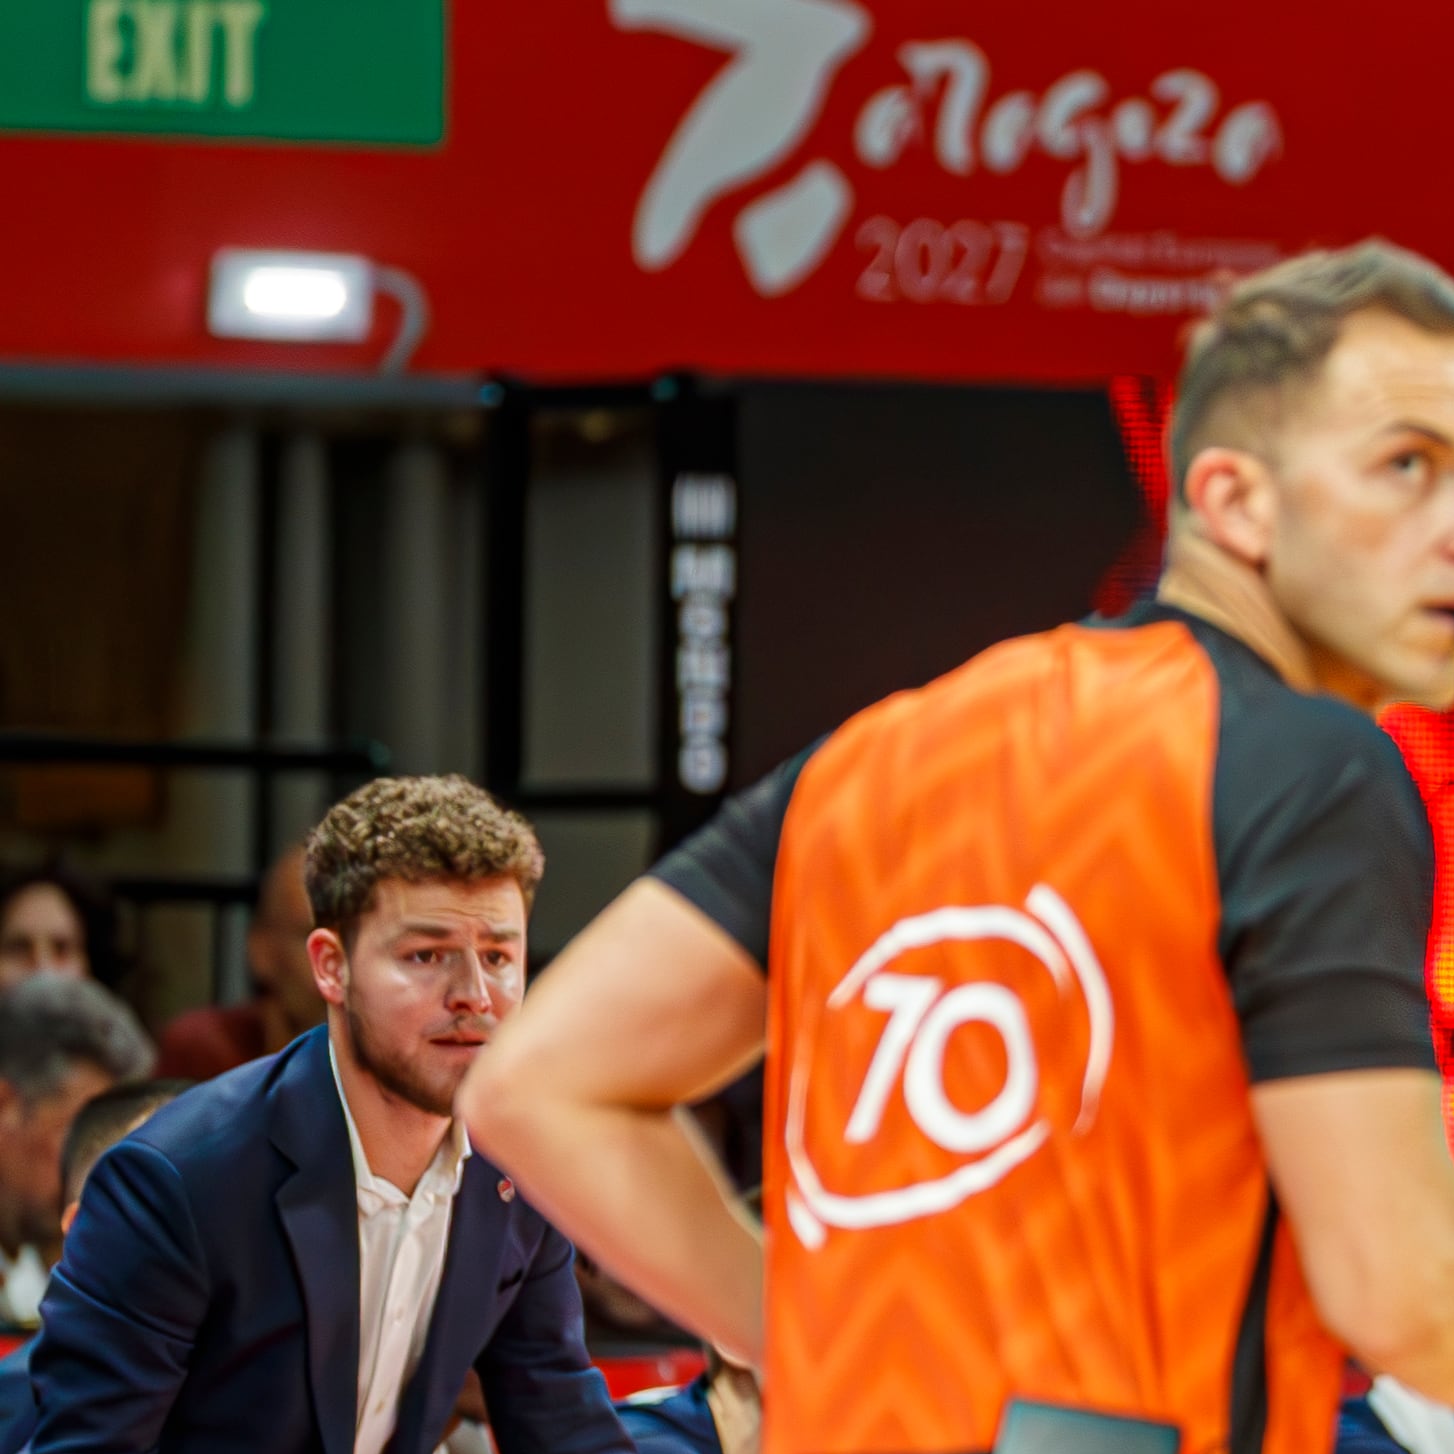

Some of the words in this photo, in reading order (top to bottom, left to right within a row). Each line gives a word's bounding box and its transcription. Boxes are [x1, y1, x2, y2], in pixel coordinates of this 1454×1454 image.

[84, 0, 267, 109] EXIT
[854, 215, 1030, 305] 2027
[843, 972, 1039, 1154] 70
